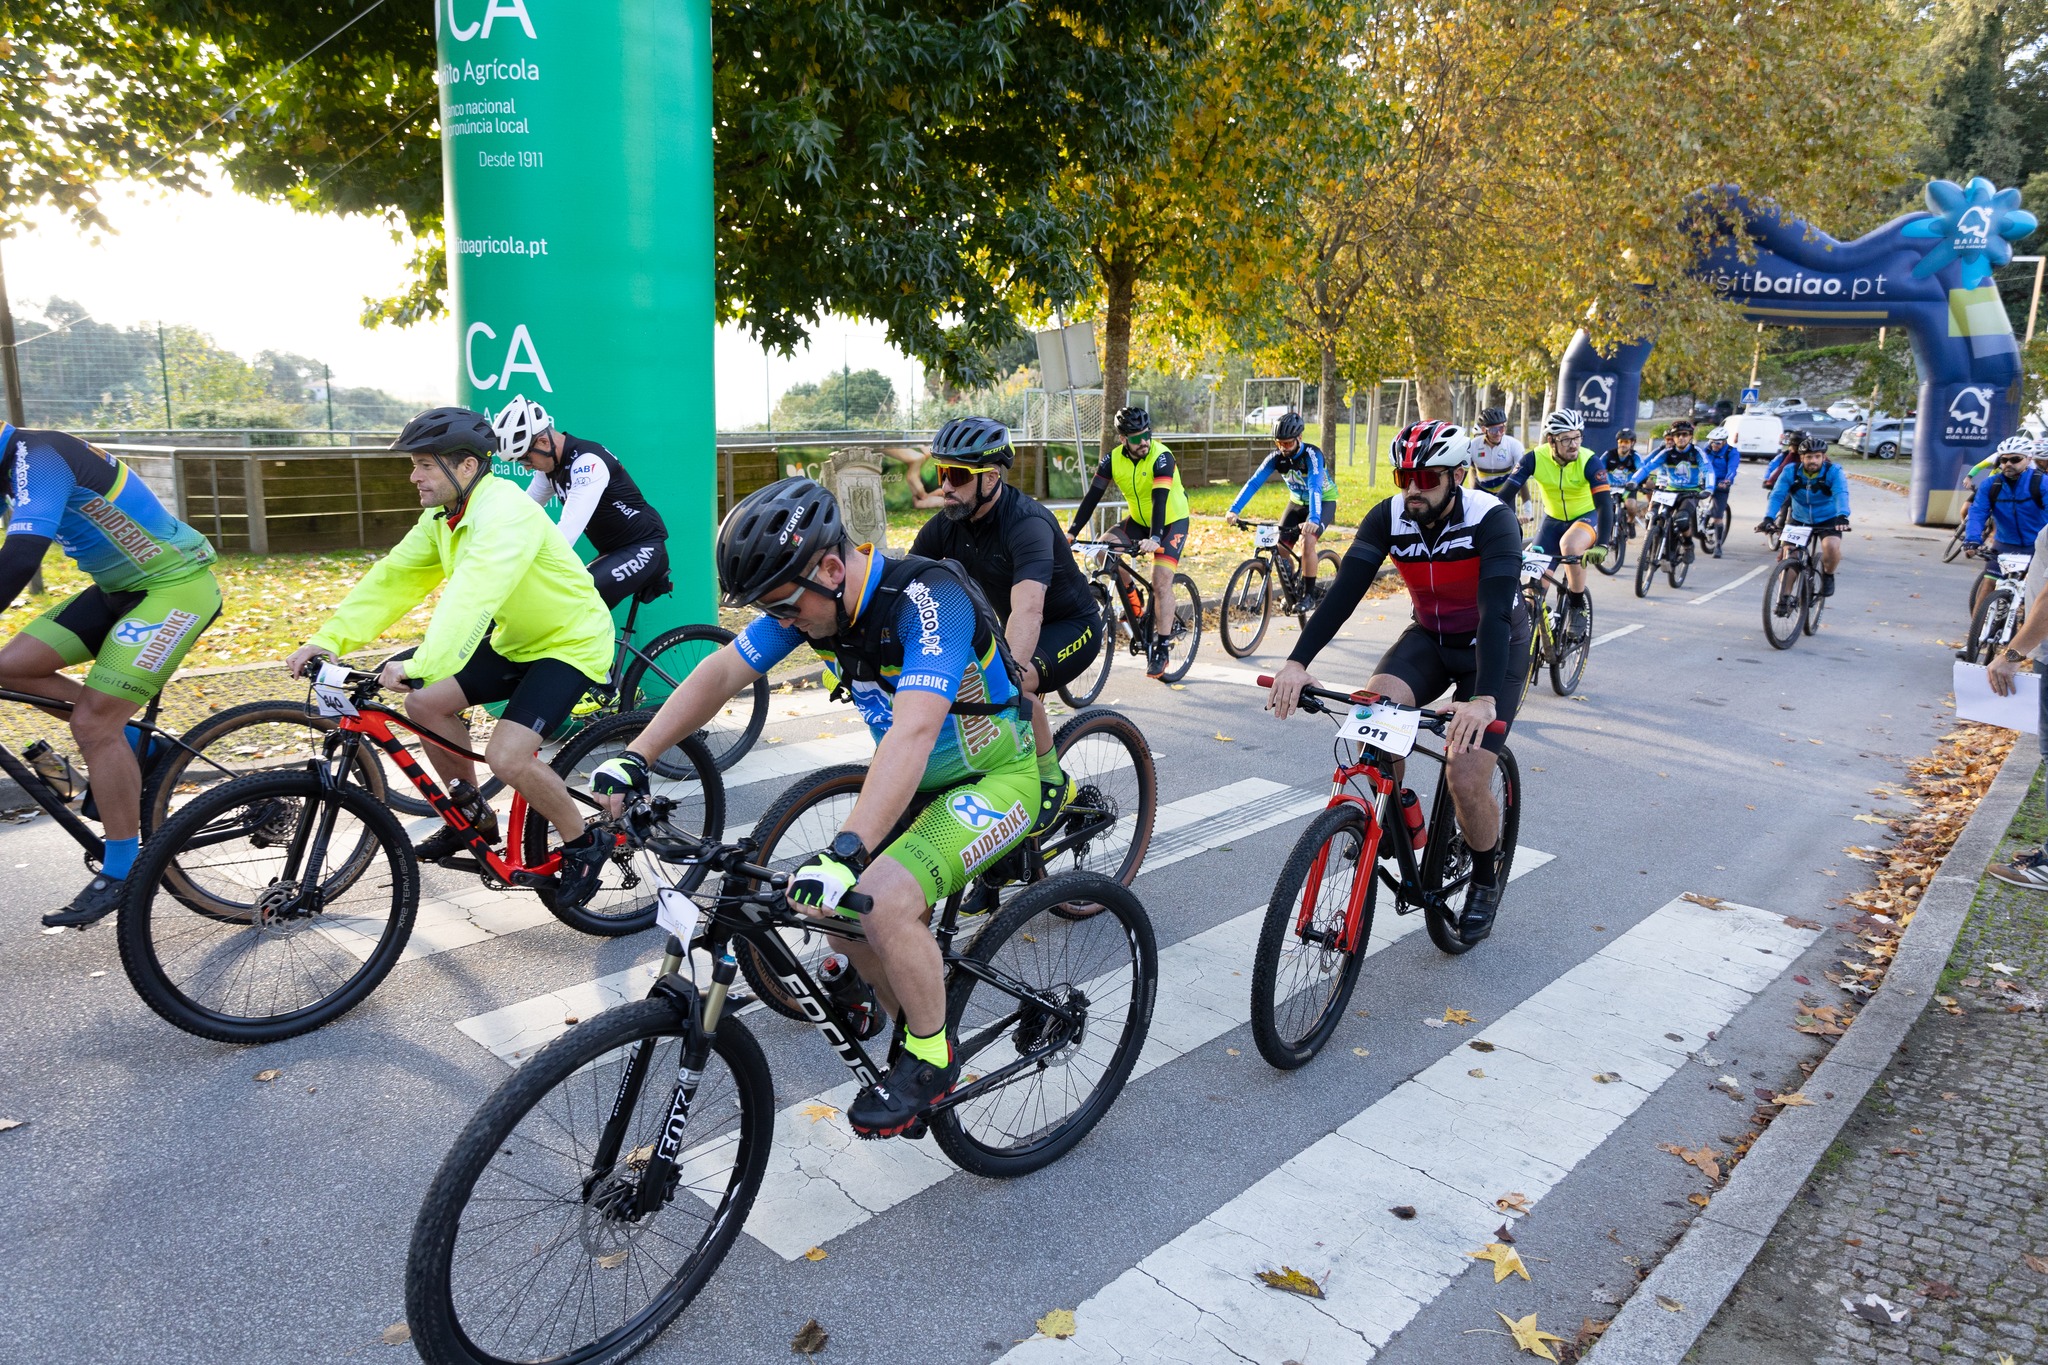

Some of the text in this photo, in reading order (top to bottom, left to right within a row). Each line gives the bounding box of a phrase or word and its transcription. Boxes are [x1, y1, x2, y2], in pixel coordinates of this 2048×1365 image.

[463, 58, 540, 86] Agrícola
[465, 98, 516, 115] nacional
[495, 117, 529, 134] local
[479, 151, 543, 168] Desde 1911
[466, 322, 553, 393] CA
[1946, 425, 1988, 434] BAIÃO
[983, 445, 1006, 457] SCOTT
[80, 498, 163, 564] BAIDEBIKE
[786, 505, 805, 534] GIRO
[1391, 536, 1475, 557] MMR
[136, 610, 191, 671] BAIDEBIKE
[650, 634, 685, 658] MAXXIS
[1057, 625, 1094, 664] SCOTT
[1114, 720, 1150, 761] SCHWALBE
[1358, 725, 1388, 742] 011
[627, 754, 645, 766] FORCE
[961, 804, 1028, 869] BAIDEBIKE
[394, 847, 411, 928] XR2 TEAM ISSUE
[779, 973, 877, 1088] FOCUS
[874, 1084, 891, 1101] FILA
